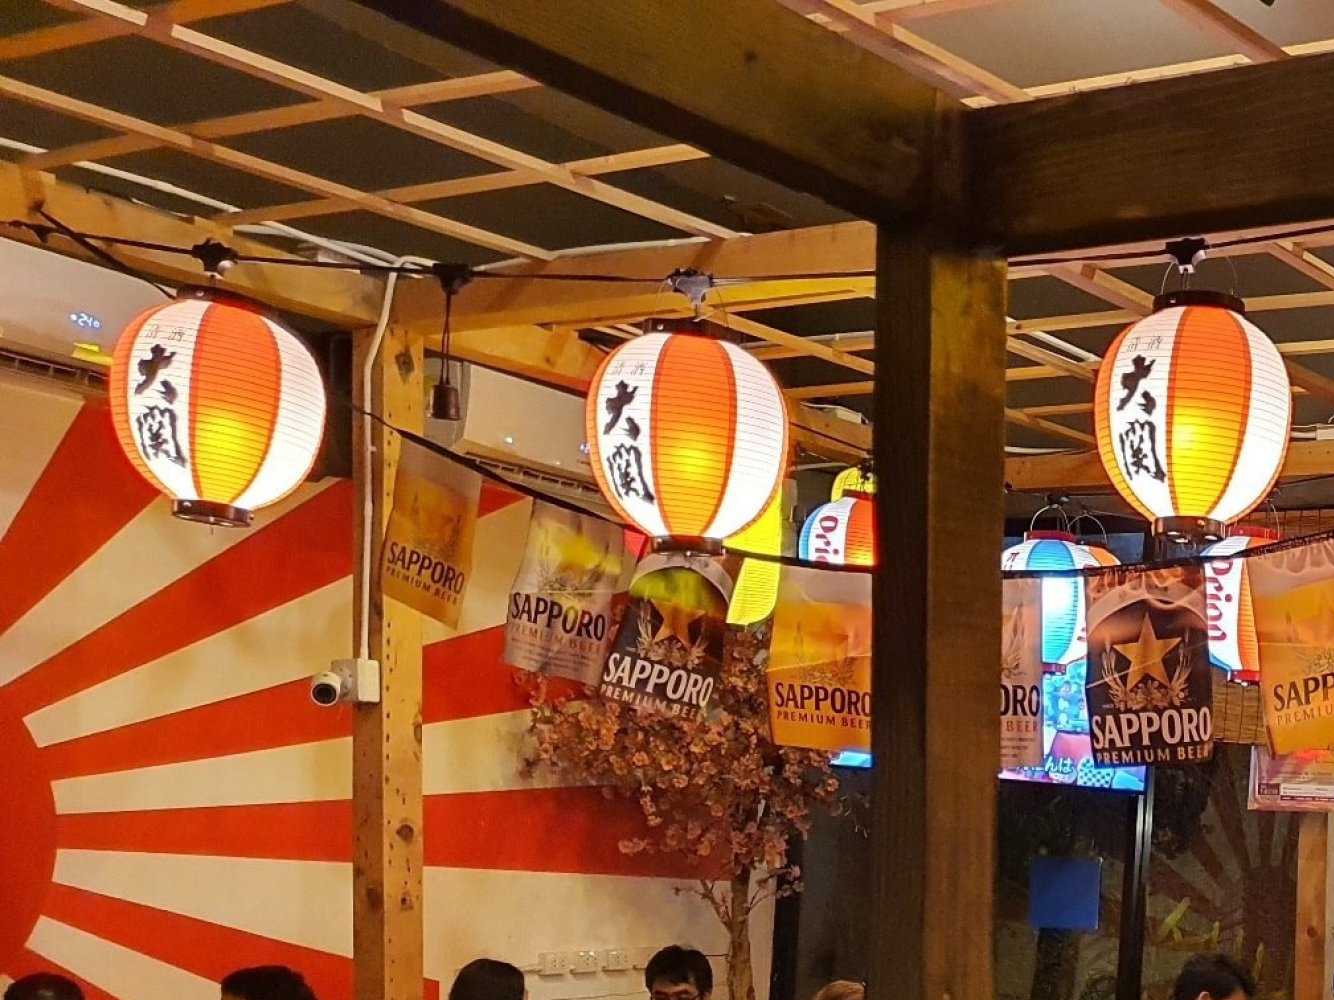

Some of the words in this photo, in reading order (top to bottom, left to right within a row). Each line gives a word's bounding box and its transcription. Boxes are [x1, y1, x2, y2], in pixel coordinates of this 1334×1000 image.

[387, 542, 464, 595] SAPPORO
[511, 592, 605, 641] SAPPORO
[1206, 557, 1233, 643] Orion
[600, 683, 667, 710] PREMIUM
[603, 652, 714, 708] SAPPORO
[776, 710, 836, 726] PREMIUM
[1091, 706, 1212, 749] SAPPORO
[1096, 748, 1171, 765] PREMIUM
[1177, 740, 1210, 760] BEER
